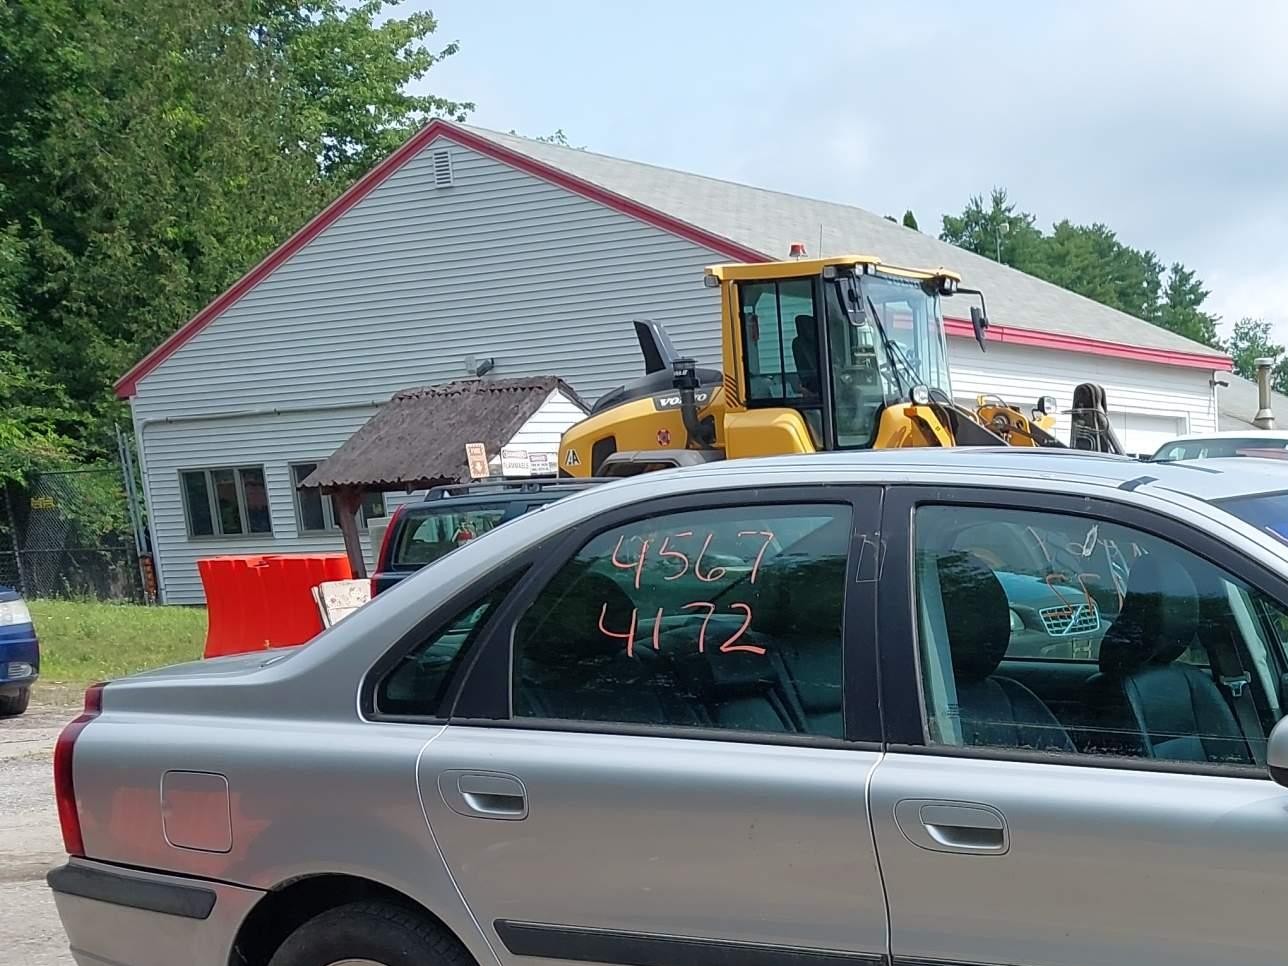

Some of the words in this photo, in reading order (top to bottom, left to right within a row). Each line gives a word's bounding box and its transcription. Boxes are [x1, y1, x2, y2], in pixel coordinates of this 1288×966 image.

[660, 393, 708, 407] VOO
[612, 531, 774, 589] 4567
[598, 602, 766, 657] 4172
